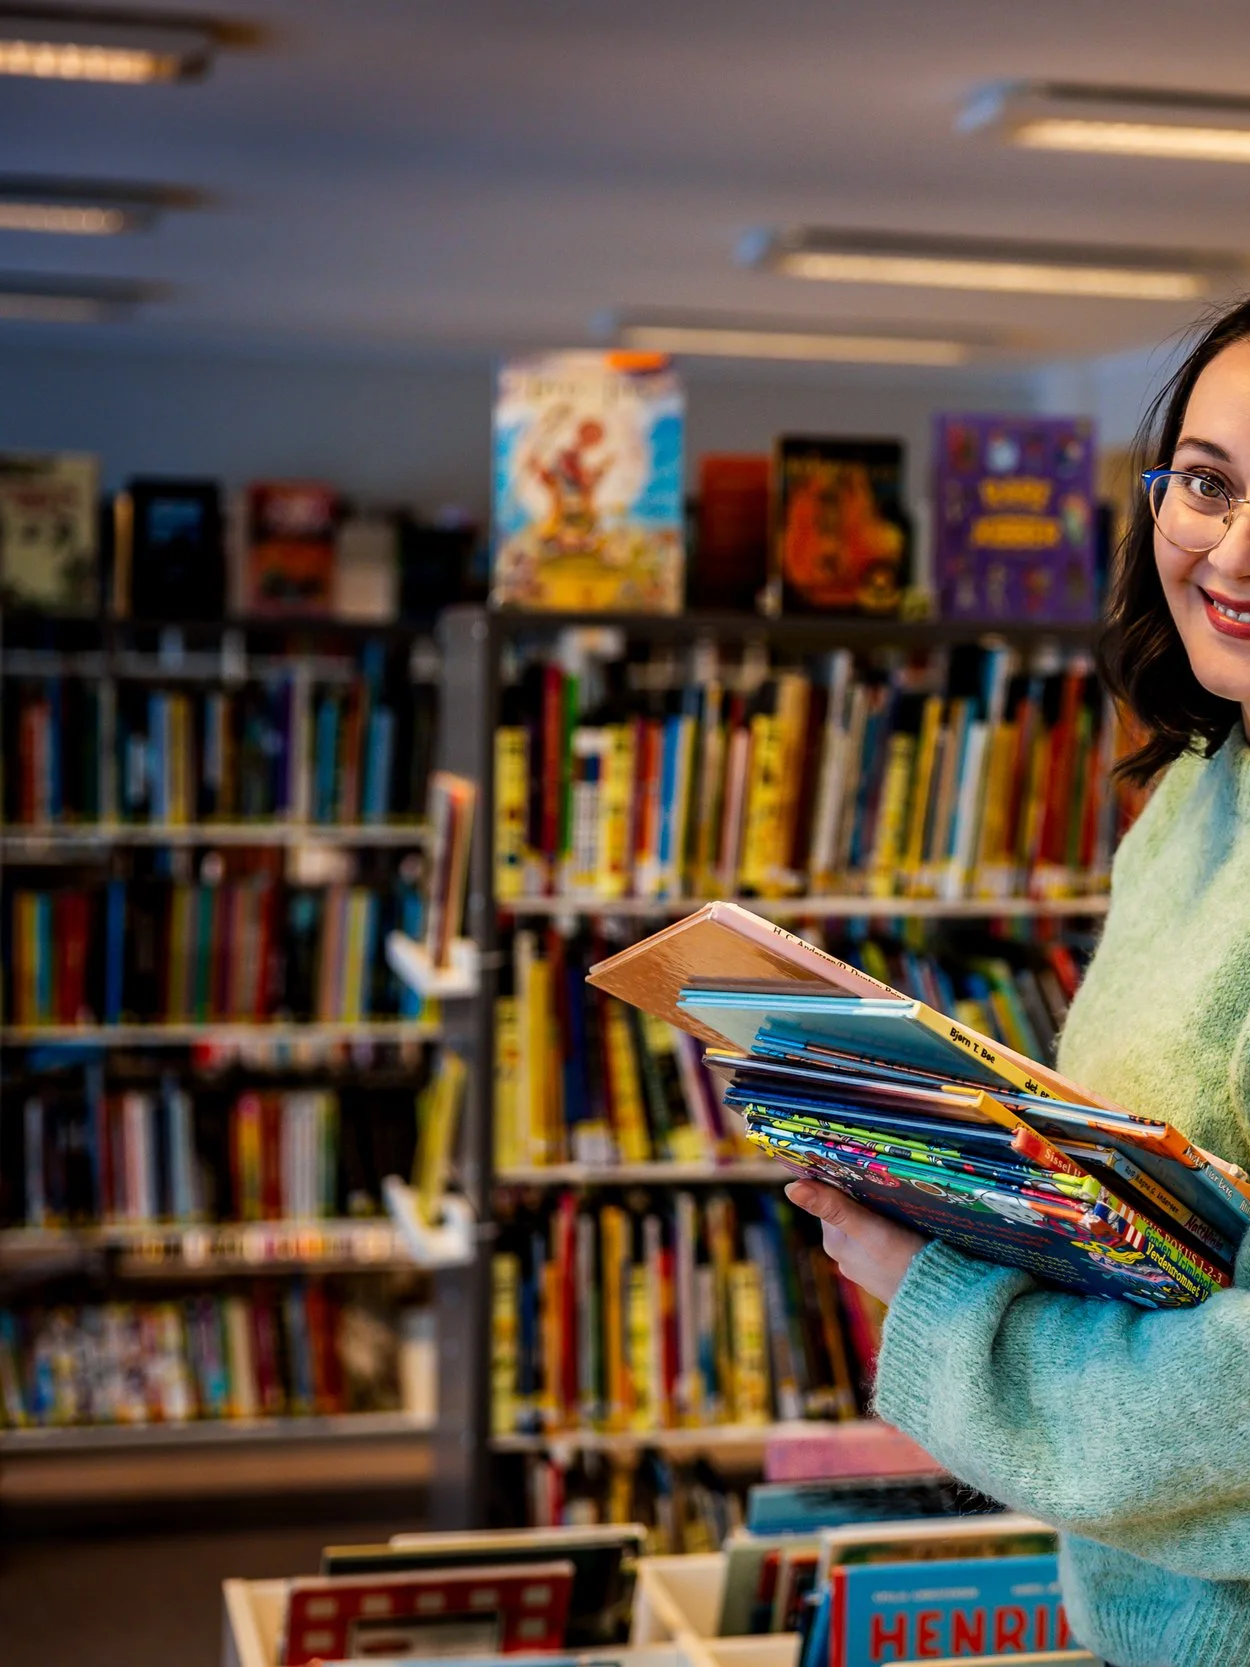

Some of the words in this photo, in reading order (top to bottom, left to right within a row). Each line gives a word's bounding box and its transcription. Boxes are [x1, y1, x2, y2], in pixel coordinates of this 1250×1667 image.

[1024, 1079, 1038, 1095] det
[1044, 1148, 1071, 1174] Sissel
[1145, 1242, 1200, 1299] Verdensrommet
[1165, 1233, 1198, 1265] POKUS
[1200, 1260, 1223, 1284] 1-2-3
